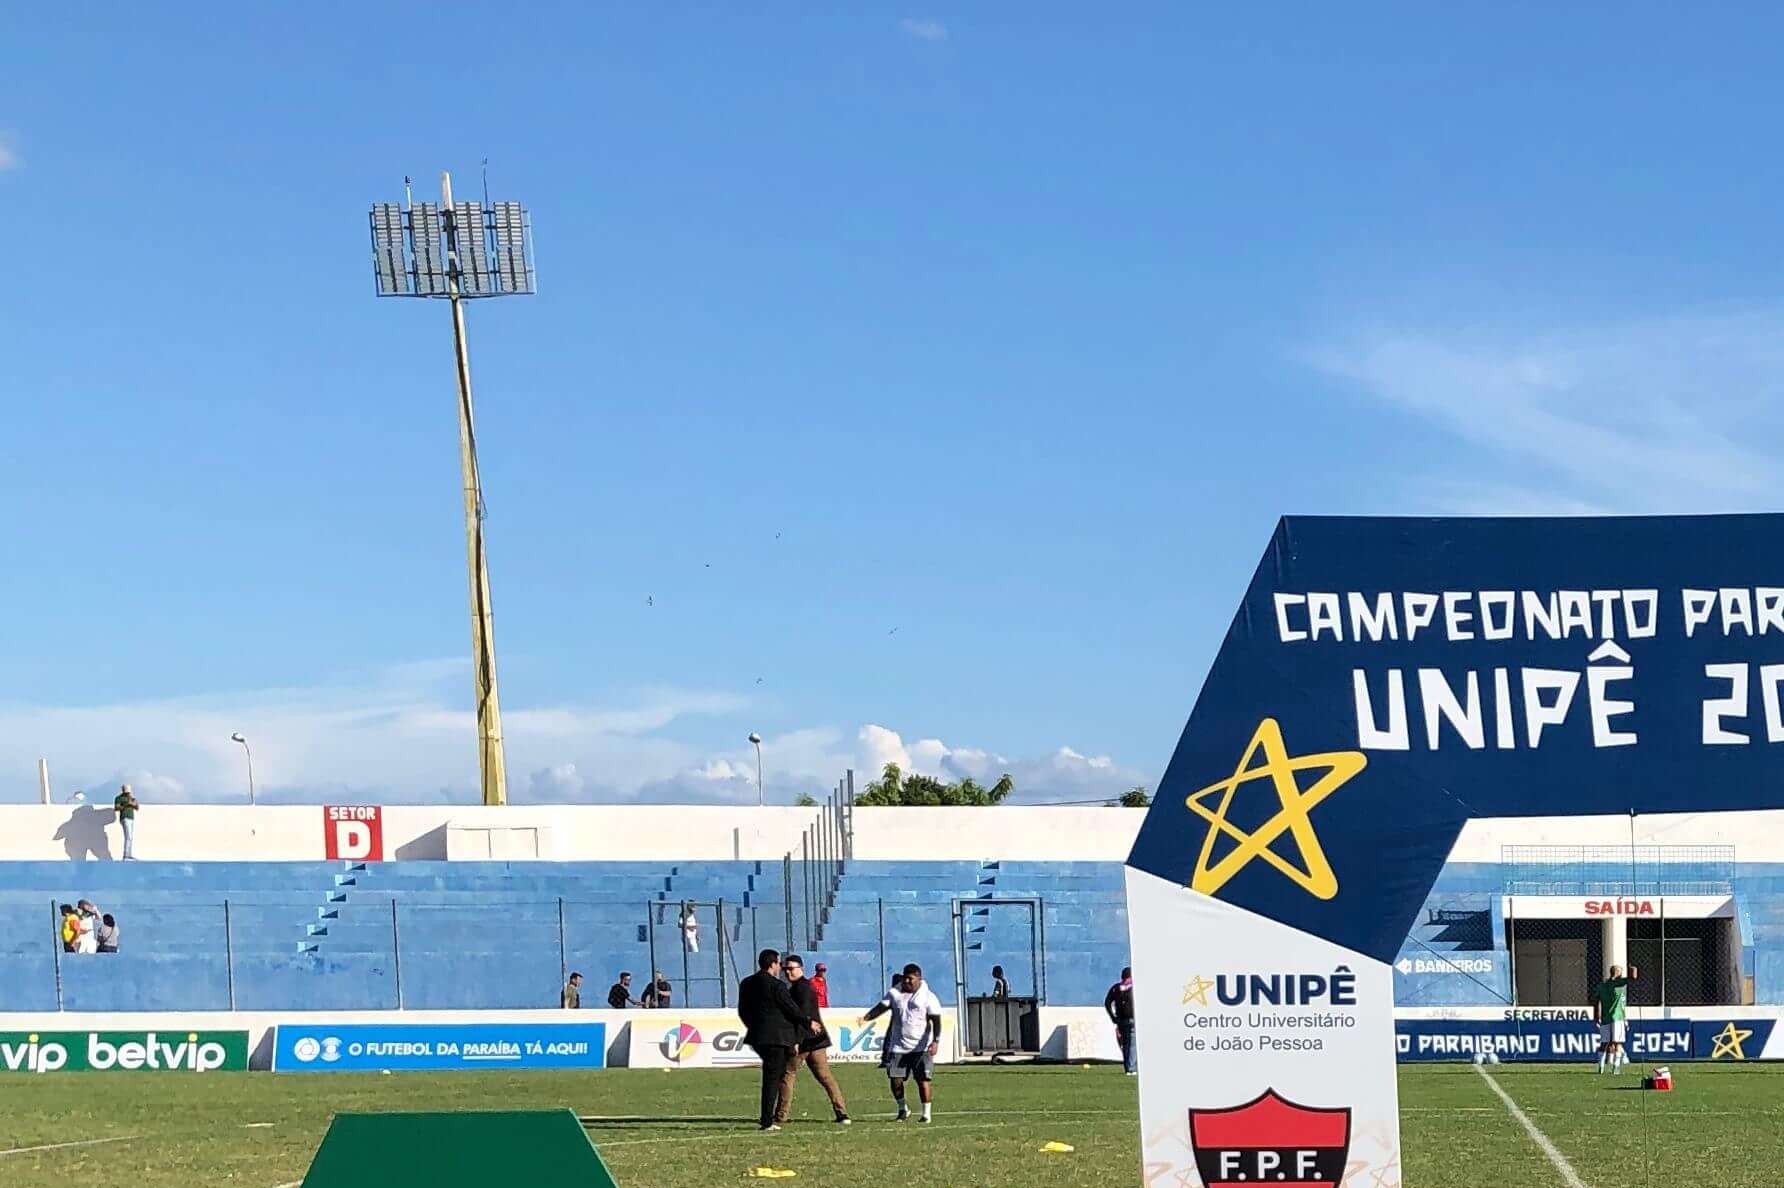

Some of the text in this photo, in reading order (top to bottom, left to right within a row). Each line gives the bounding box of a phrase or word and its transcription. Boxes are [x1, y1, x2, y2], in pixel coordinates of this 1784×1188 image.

[1274, 589, 1658, 642] CAMPEONATO
[1352, 639, 1638, 750] UNIPÊ
[328, 807, 376, 820] SETOR
[336, 820, 371, 859] D
[1584, 897, 1654, 915] SAÍDA
[1216, 965, 1357, 1007] UNIPÊ
[1183, 1012, 1356, 1028] Centro Universitário
[1503, 1009, 1590, 1021] SECRETARIA
[348, 1039, 588, 1056] O FUTEBOL DA PARAÍBA TÁ AQUI!
[1184, 1035, 1323, 1051] de João Pessoa
[1418, 1034, 1541, 1053] PARAIBANO
[1633, 1032, 1691, 1052] 2024
[88, 1033, 227, 1073] betvip
